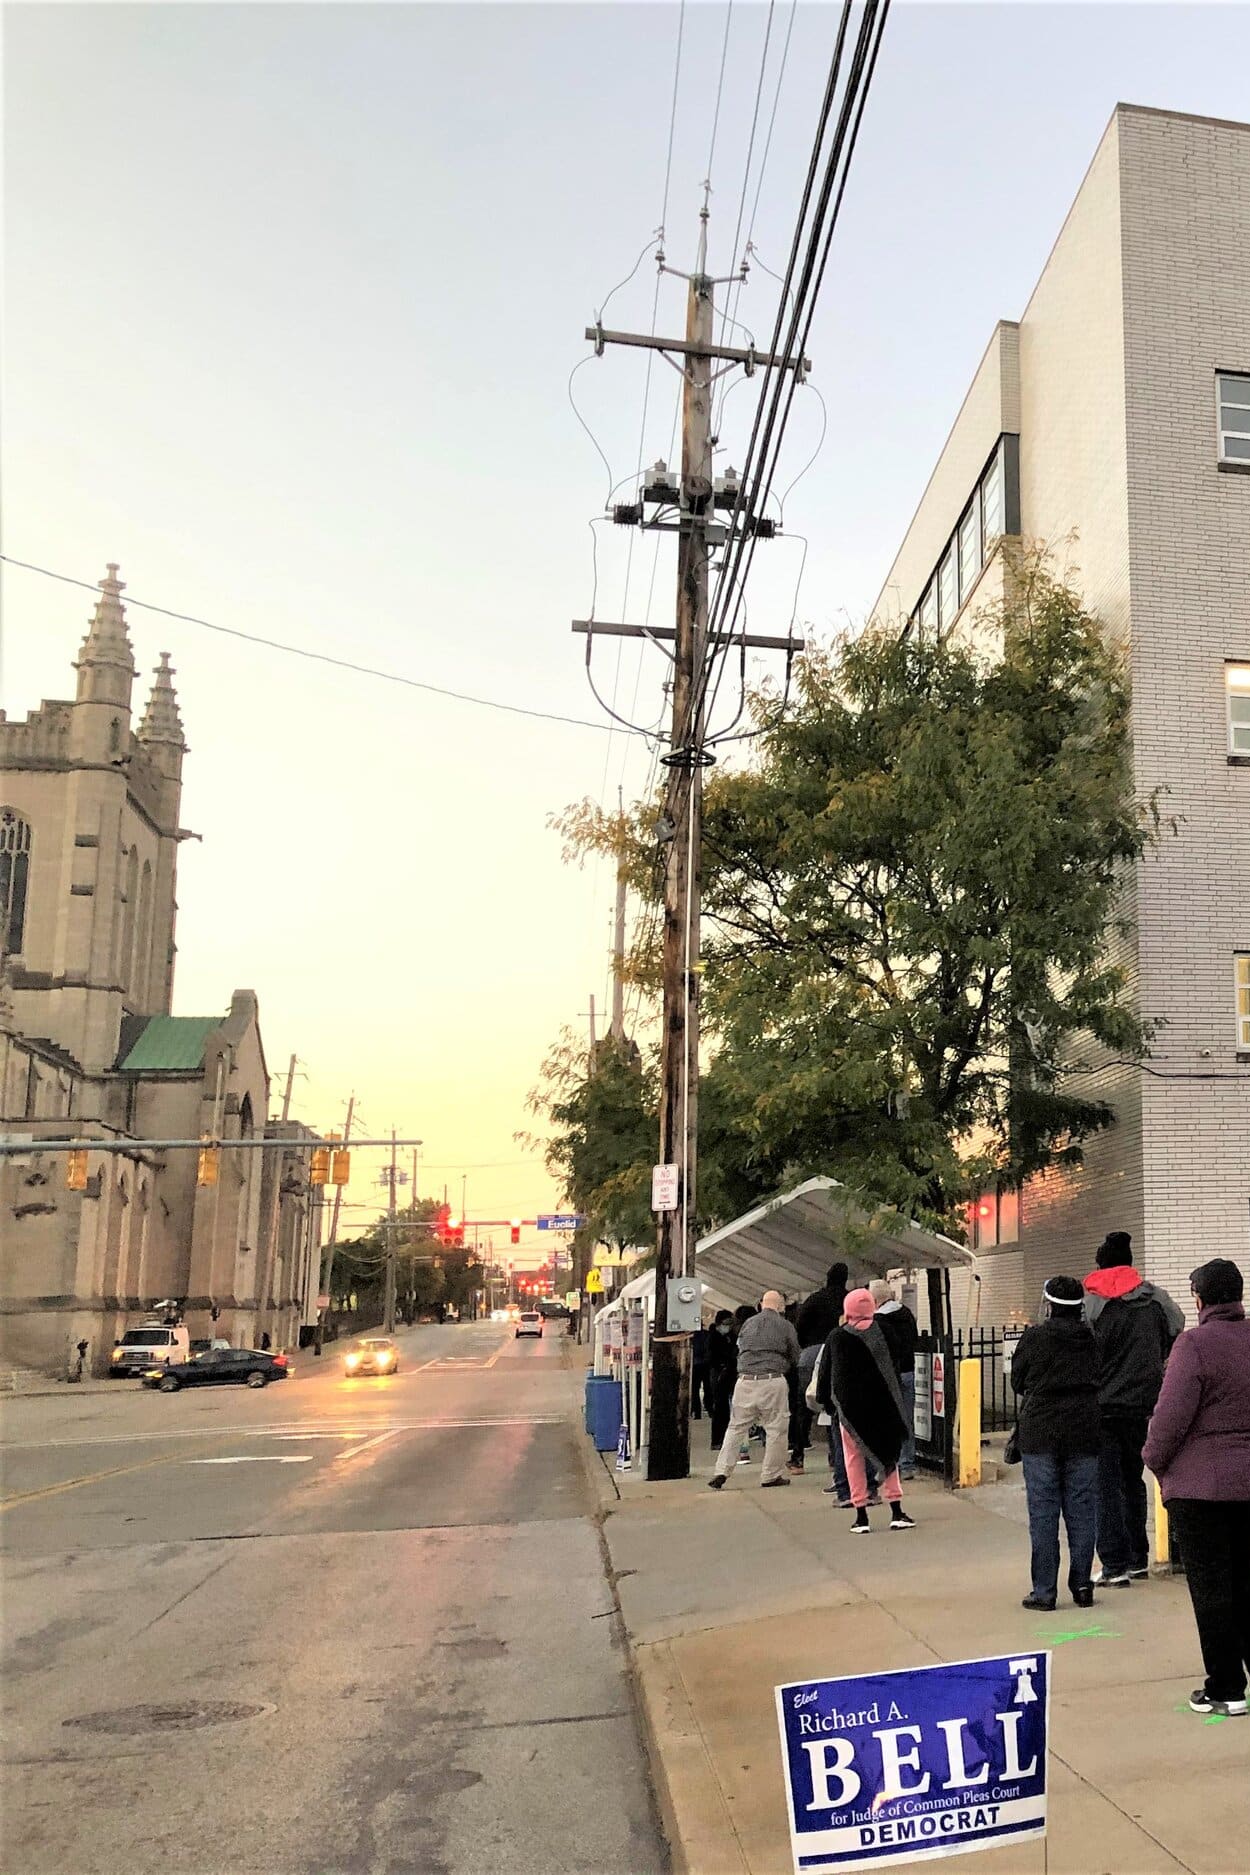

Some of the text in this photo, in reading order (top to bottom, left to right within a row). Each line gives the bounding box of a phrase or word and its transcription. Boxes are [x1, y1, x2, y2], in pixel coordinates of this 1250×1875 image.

[548, 1219, 577, 1229] Euclid
[793, 1690, 819, 1709] Elect
[799, 1701, 909, 1735] Richard A.
[801, 1711, 1038, 1811] BELL
[831, 1785, 1020, 1826] for Judge of Common Pleas Court
[859, 1806, 1001, 1847] DEMOCRAT
